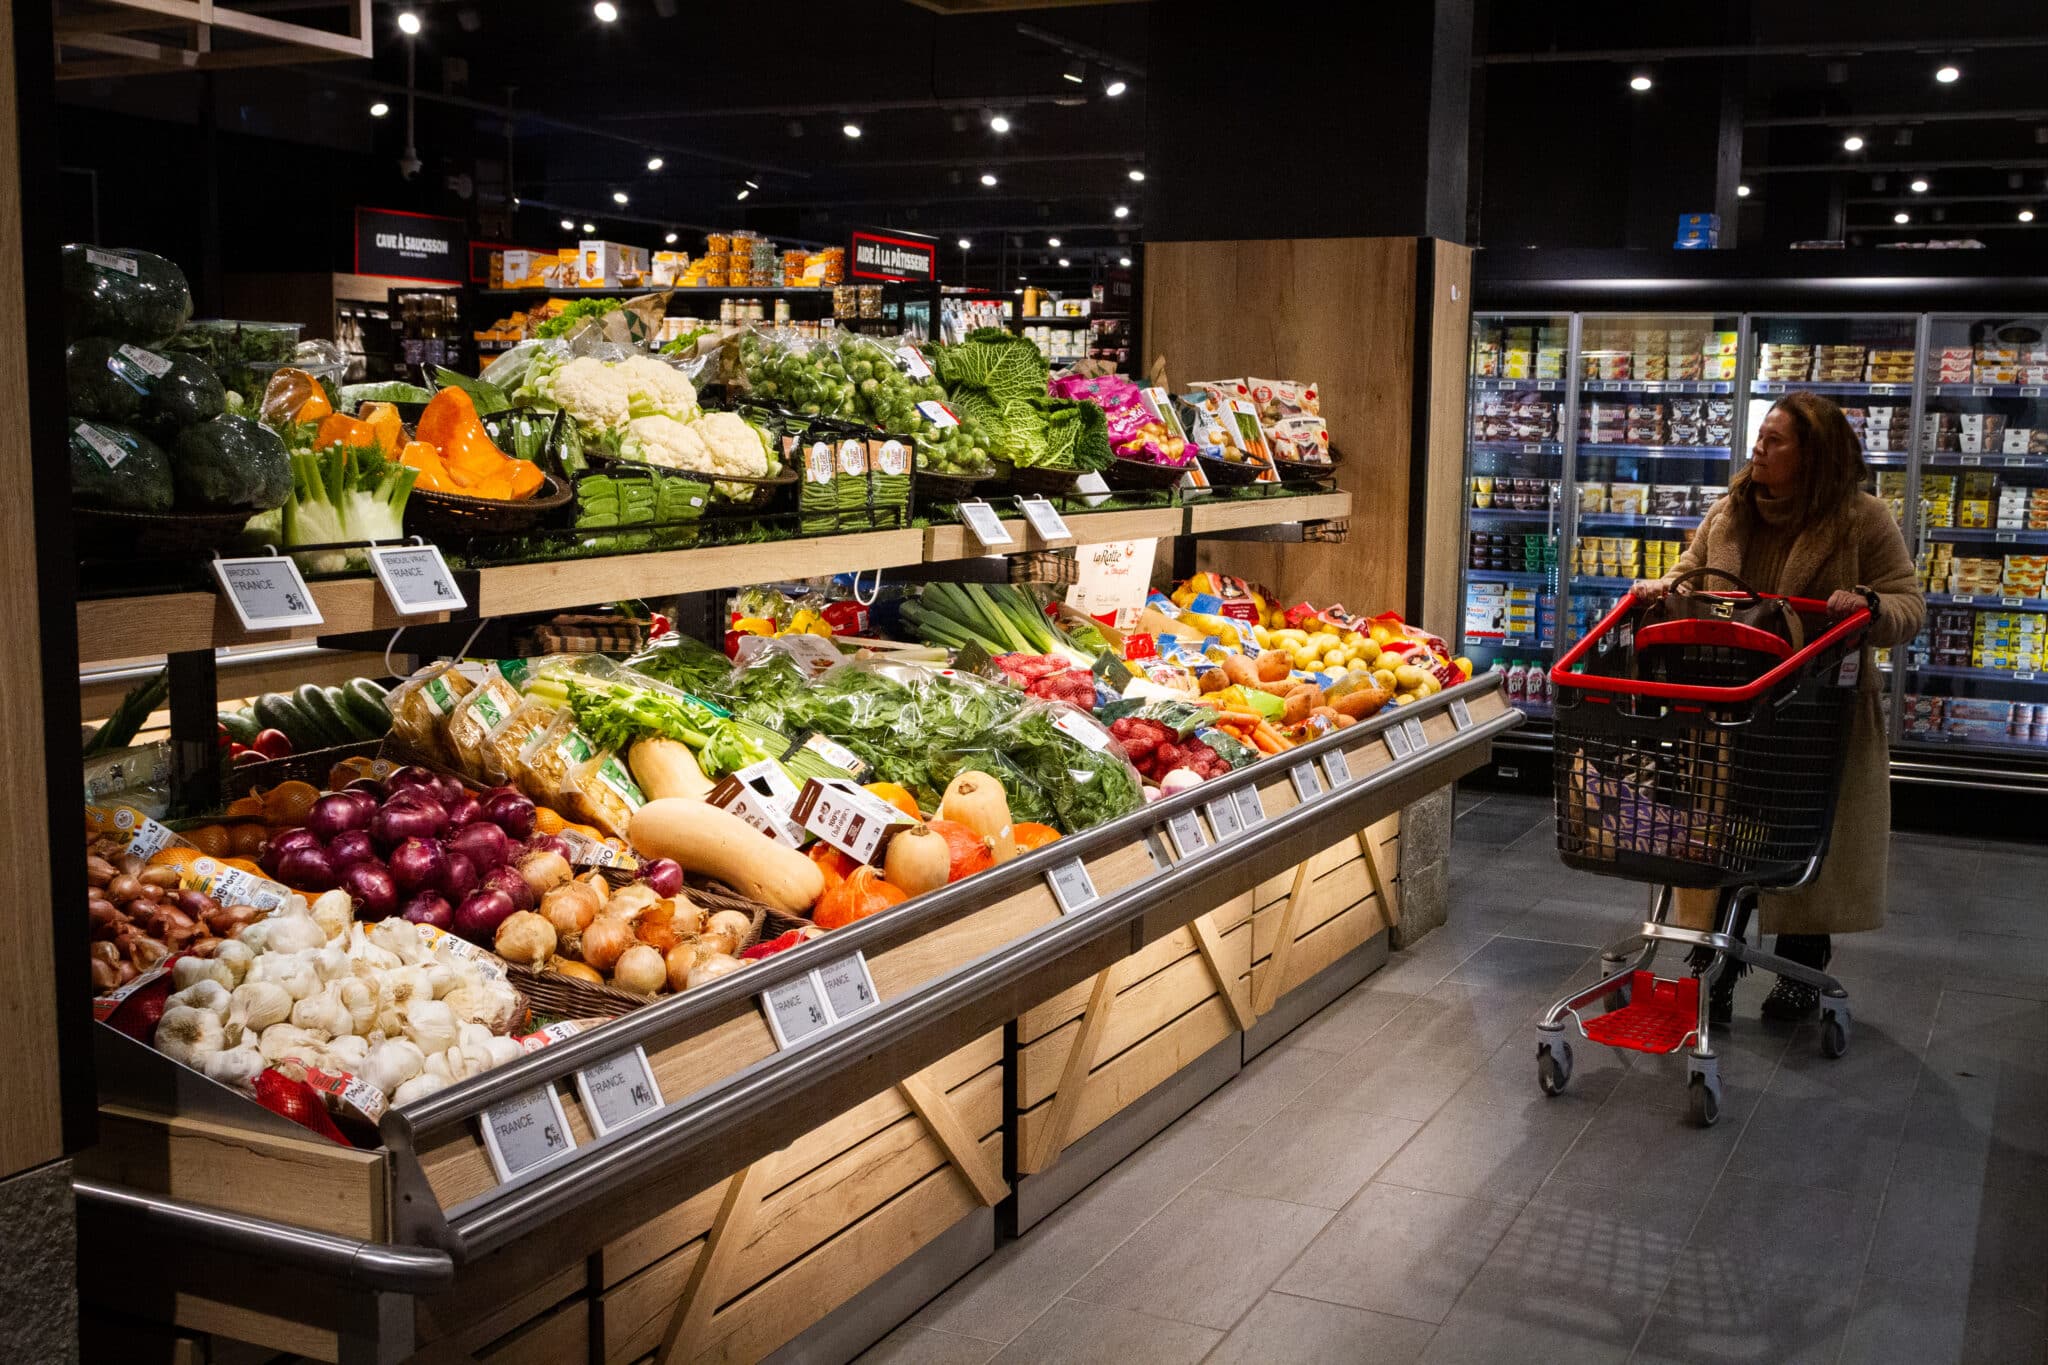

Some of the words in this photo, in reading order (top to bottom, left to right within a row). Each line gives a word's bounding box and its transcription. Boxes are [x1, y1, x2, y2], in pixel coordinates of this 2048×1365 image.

[376, 233, 397, 249] CAVE
[405, 236, 449, 254] SAUCISSON
[857, 245, 874, 264] AIDE
[881, 249, 890, 267] LA
[389, 567, 425, 578] FRANCE
[232, 579, 275, 592] FRANCE
[591, 1071, 626, 1094] FRANCE
[495, 1113, 535, 1137] FRANCE
